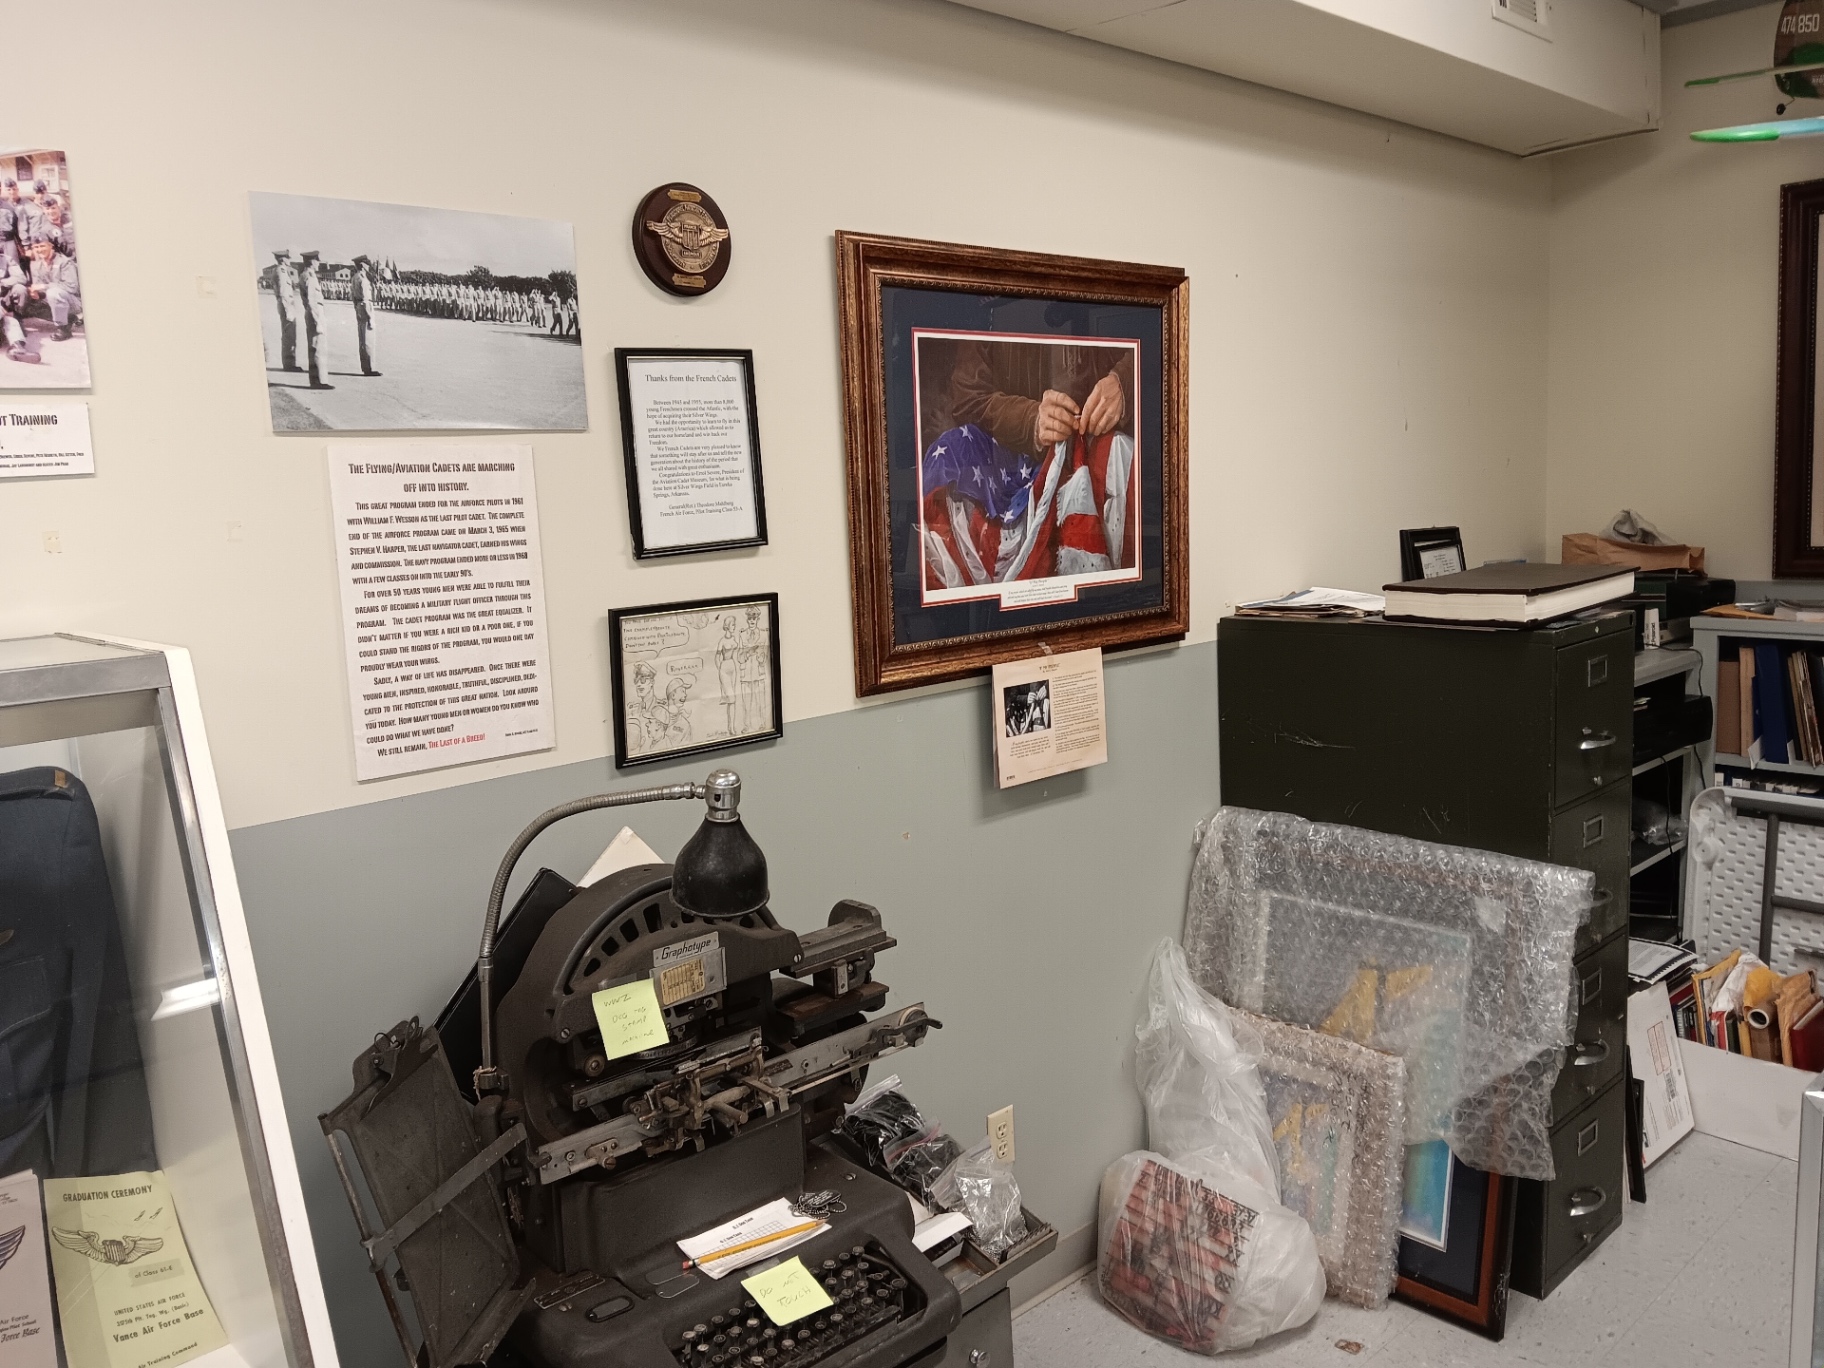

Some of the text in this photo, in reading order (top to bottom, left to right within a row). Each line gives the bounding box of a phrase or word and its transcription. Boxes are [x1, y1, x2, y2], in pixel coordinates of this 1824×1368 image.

[1798, 14, 1820, 33] 850
[8, 414, 58, 426] TRAINING
[348, 462, 515, 474] THE FLYING/AVIATION CADETS ARE MARCHING
[403, 482, 469, 492] OFF INTO HISTORY.
[355, 502, 369, 510] THIS
[363, 517, 389, 525] WILLIAM
[395, 515, 419, 524] WESSON
[412, 529, 440, 537] PROGRAM
[496, 525, 509, 533] 1965
[349, 547, 375, 555] STEPHEN
[356, 619, 386, 629] PROGRAM.
[392, 617, 404, 625] THE
[405, 616, 422, 624] CADET
[424, 614, 451, 622] PROGRAM
[360, 663, 385, 672] PROUDLY
[386, 661, 403, 669] WEAR
[403, 659, 419, 667] YOUR
[362, 692, 382, 701] YOUNG
[366, 735, 385, 744] COULD
[394, 731, 410, 740] WHAT
[422, 727, 436, 736] HAVE
[436, 724, 454, 734] DONE?
[377, 748, 388, 757] WE
[388, 746, 403, 755] STILL
[440, 739, 452, 747] LAST
[661, 938, 712, 960] Graphotype
[63, 1184, 152, 1202] GRADUATION CEREMONY
[760, 1286, 774, 1298] DO
[777, 1286, 811, 1306] TOUCH
[114, 1306, 134, 1316] UNITED
[136, 1301, 154, 1310] STATES
[169, 1292, 186, 1302] FORCE
[113, 1309, 204, 1342] Vance Air Force Base
[147, 1354, 170, 1366] Training
[172, 1342, 198, 1356] Command
